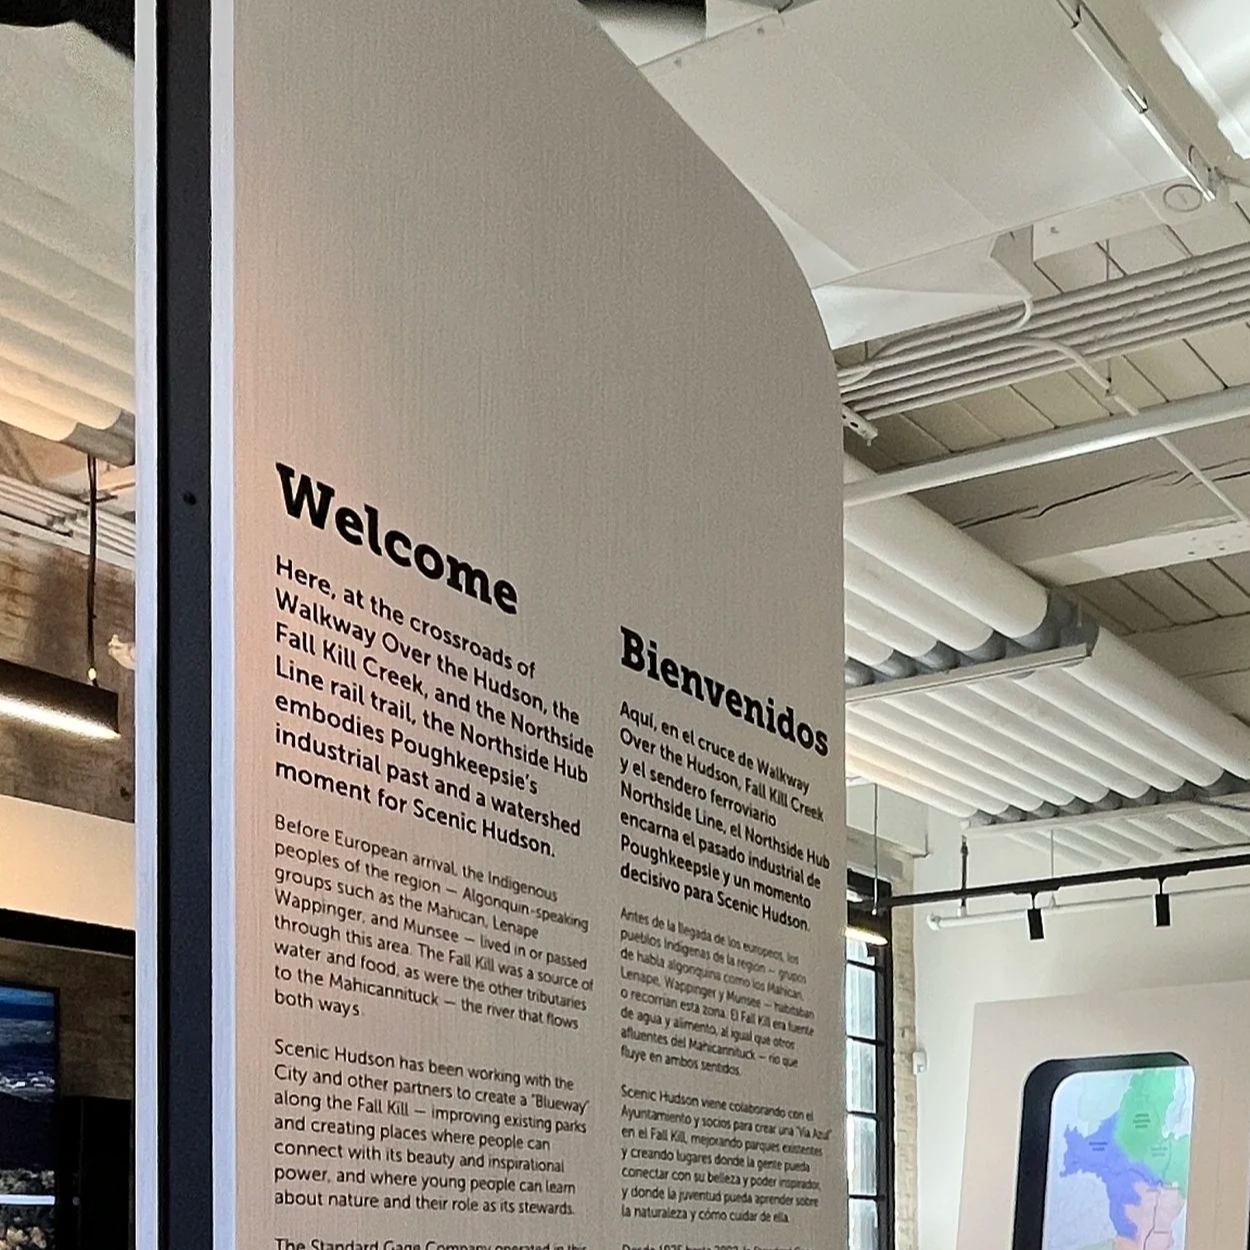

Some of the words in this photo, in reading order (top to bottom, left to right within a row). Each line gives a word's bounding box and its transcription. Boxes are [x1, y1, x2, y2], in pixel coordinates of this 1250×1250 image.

[276, 462, 518, 614] Welcome
[275, 587, 376, 648] Walkway
[382, 632, 431, 666] Over
[437, 654, 468, 681] the
[474, 667, 547, 715] Hudson,
[552, 700, 579, 725] the
[276, 554, 336, 600] Here,
[343, 588, 364, 609] at
[370, 595, 404, 625] the
[410, 617, 512, 669] crossroads
[517, 661, 535, 679] of
[275, 695, 384, 743] embodies
[276, 621, 316, 656] Fall
[323, 639, 356, 670] Kill
[363, 656, 428, 699] Creek,
[434, 687, 470, 712] and
[475, 699, 505, 725] the
[511, 711, 594, 758] Northside
[276, 654, 323, 691] Line
[331, 680, 365, 706] rail
[370, 691, 416, 725] trail,
[422, 709, 455, 736] the
[460, 722, 549, 770] Northside
[554, 755, 588, 783] Hub
[619, 626, 829, 757] Bienvenidos
[275, 722, 381, 774] industrial
[387, 763, 429, 790] past
[434, 778, 470, 802] and
[476, 791, 486, 807] a
[491, 796, 580, 836] watershed
[619, 700, 657, 731] Aquí,
[661, 721, 678, 739] en
[682, 729, 695, 746] el
[698, 737, 735, 762] cruce
[738, 751, 753, 770] de
[756, 758, 809, 795] Walkway
[620, 727, 656, 754] Over
[660, 743, 682, 766] the
[687, 753, 741, 791] Hudson,
[745, 777, 766, 799] Fall
[769, 787, 788, 808] Kill
[790, 796, 824, 822] Creek
[620, 757, 628, 774] y
[632, 760, 646, 778] el
[650, 769, 707, 800] sendero
[710, 788, 776, 826] ferroviario
[275, 761, 371, 804] moment
[378, 788, 407, 813] for
[413, 798, 477, 834] Scenic
[482, 818, 555, 857] Hudson.
[620, 811, 679, 842] encarna
[682, 831, 695, 848] el
[698, 838, 745, 863] pasado
[748, 852, 804, 884] industrial
[806, 872, 821, 889] de
[621, 780, 691, 820] Northside
[695, 807, 726, 834] Line,
[730, 823, 742, 838] el
[745, 825, 803, 860] Northside
[807, 848, 830, 869] Hub
[620, 862, 680, 893] decisivo
[684, 884, 713, 903] para
[717, 890, 758, 917] Scenic
[762, 904, 810, 931] Hudson.
[621, 834, 720, 880] Poughkeepsie
[722, 871, 730, 887] y
[733, 875, 750, 890] un
[753, 881, 811, 909] momento
[274, 1038, 329, 1060] Scenic
[334, 1046, 395, 1068] Hudson
[399, 1054, 424, 1072] has
[428, 1058, 463, 1077] been
[467, 1068, 521, 1086] working
[524, 1073, 551, 1087] with
[554, 1076, 574, 1091] the
[274, 1116, 305, 1131] and
[311, 1120, 375, 1141] creating
[380, 1124, 427, 1141] places
[431, 1128, 475, 1145] where
[479, 1134, 524, 1150] people
[527, 1138, 550, 1151] can
